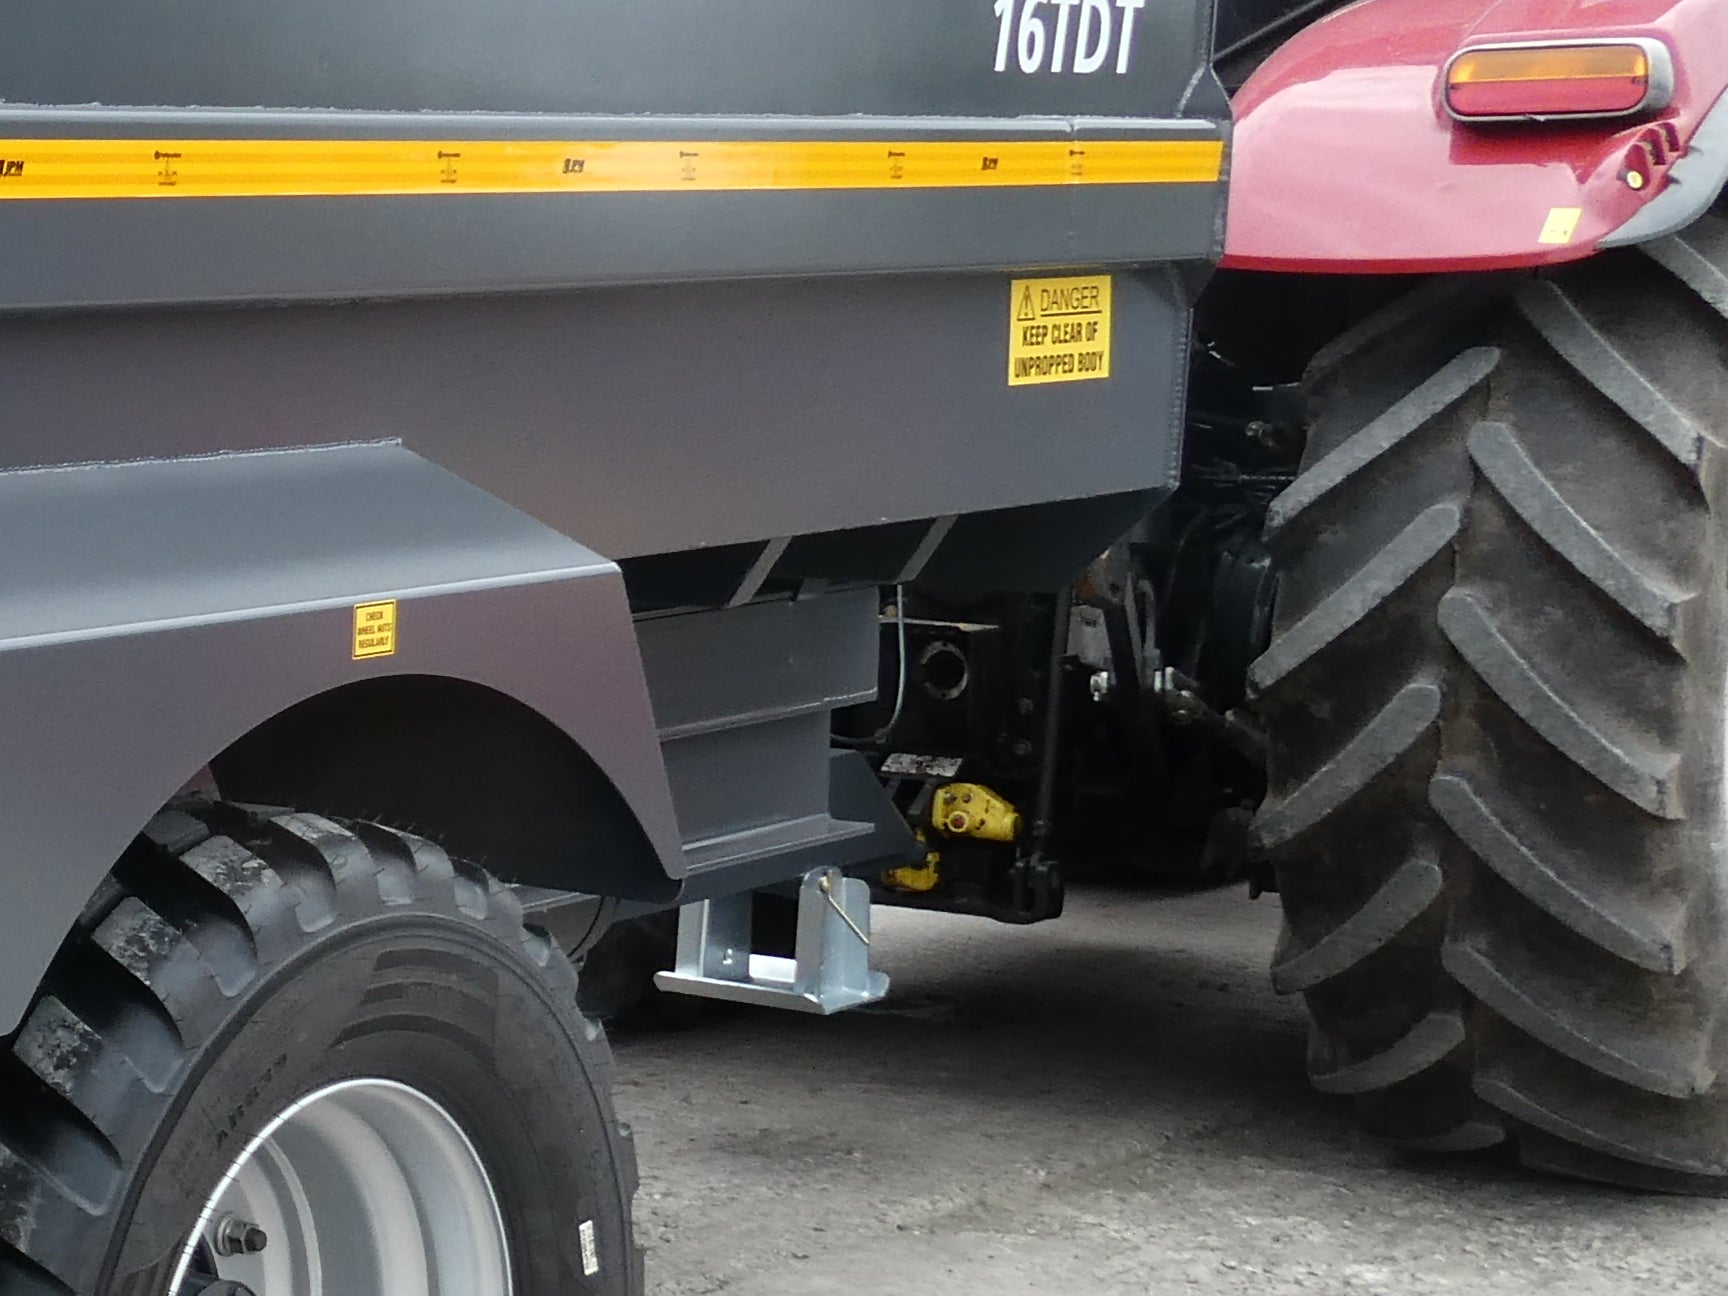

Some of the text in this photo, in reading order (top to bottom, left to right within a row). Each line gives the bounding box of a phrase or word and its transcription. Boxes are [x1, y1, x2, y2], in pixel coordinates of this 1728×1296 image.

[1041, 286, 1099, 311] DANGER
[1022, 321, 1098, 346] KEEP CLEAR OF
[1078, 350, 1104, 372] BODY
